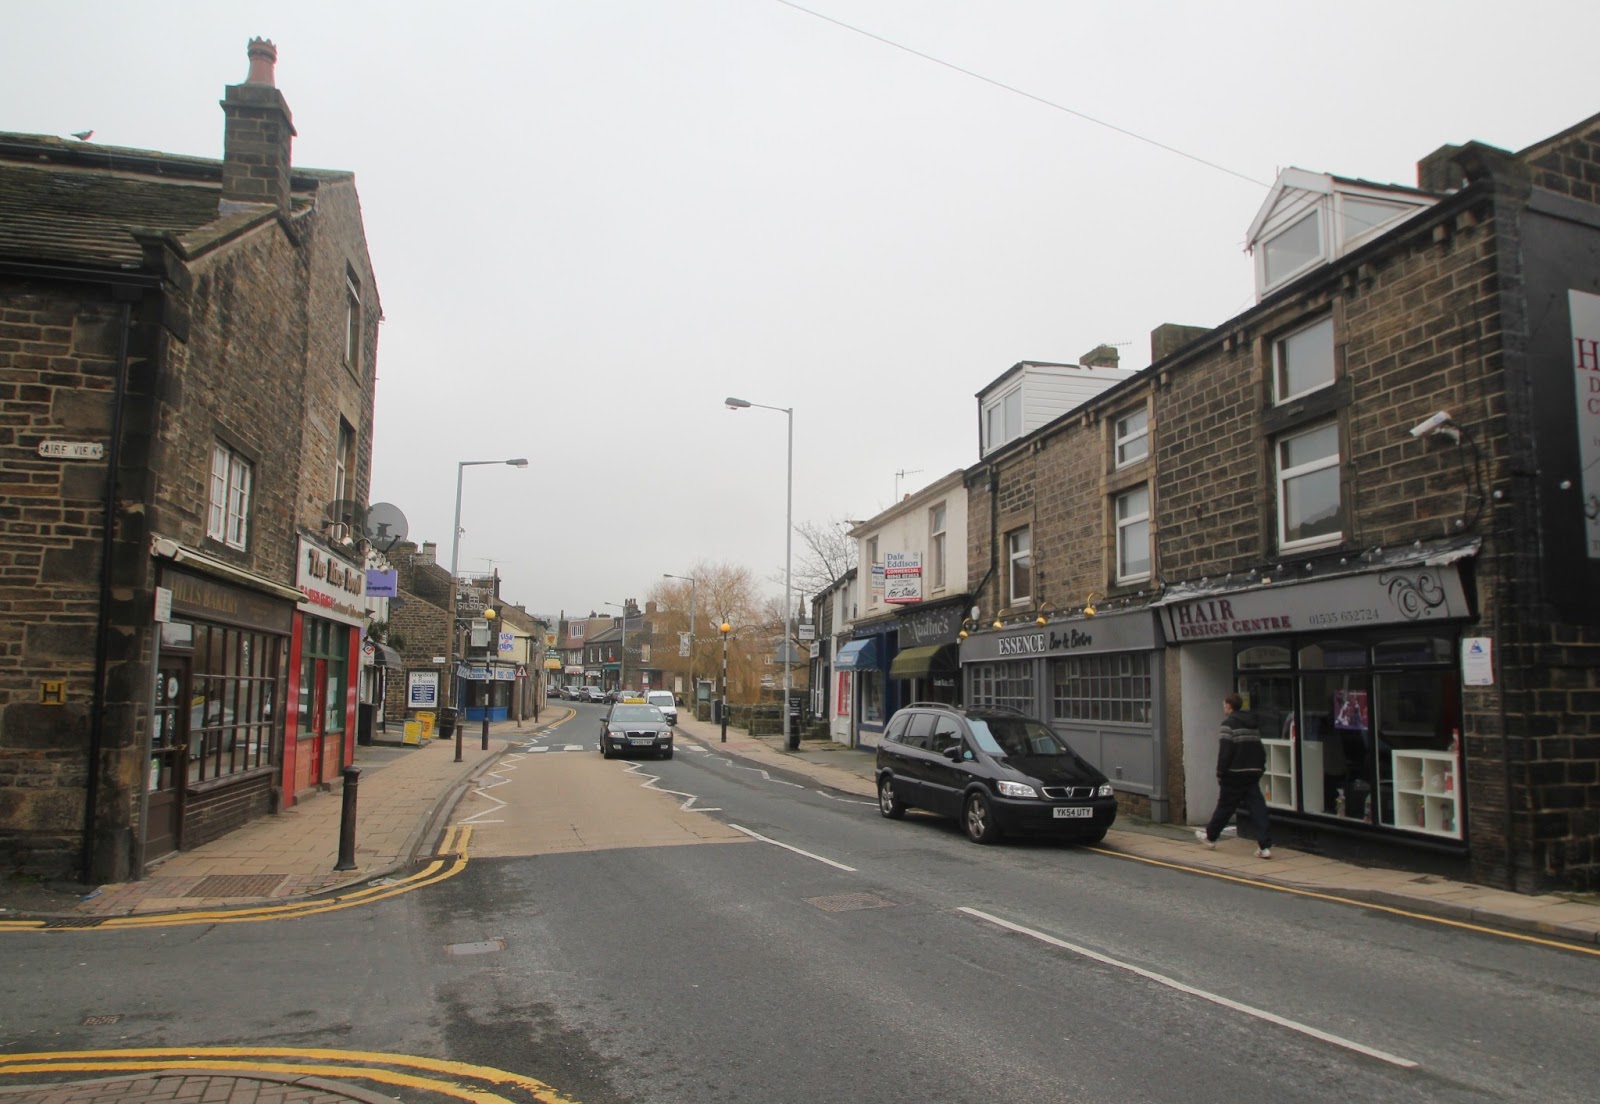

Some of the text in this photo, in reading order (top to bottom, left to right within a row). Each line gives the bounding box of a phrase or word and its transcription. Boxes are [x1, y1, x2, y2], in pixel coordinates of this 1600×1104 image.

[43, 444, 68, 455] AIRE
[887, 553, 905, 561] Dale
[308, 548, 327, 580] The
[887, 560, 919, 568] Eddison
[886, 567, 920, 575] COMMERCIAL
[171, 579, 201, 605] HILLS
[203, 589, 239, 614] BAKERY
[888, 587, 900, 598] For
[899, 587, 919, 598] Sale
[457, 601, 493, 611] SILSDEN
[1178, 599, 1235, 624] HAIR
[1308, 608, 1380, 625] 01535 652724
[1180, 615, 1292, 638] DESIGN CENTRE
[500, 633, 513, 641] FISH
[998, 633, 1046, 655] ESSENCE
[1049, 631, 1062, 650] Bar
[1070, 628, 1093, 649] Bistro
[499, 643, 514, 651] CHIPS
[41, 682, 64, 703] H
[1056, 808, 1091, 817] YK54 UTY
